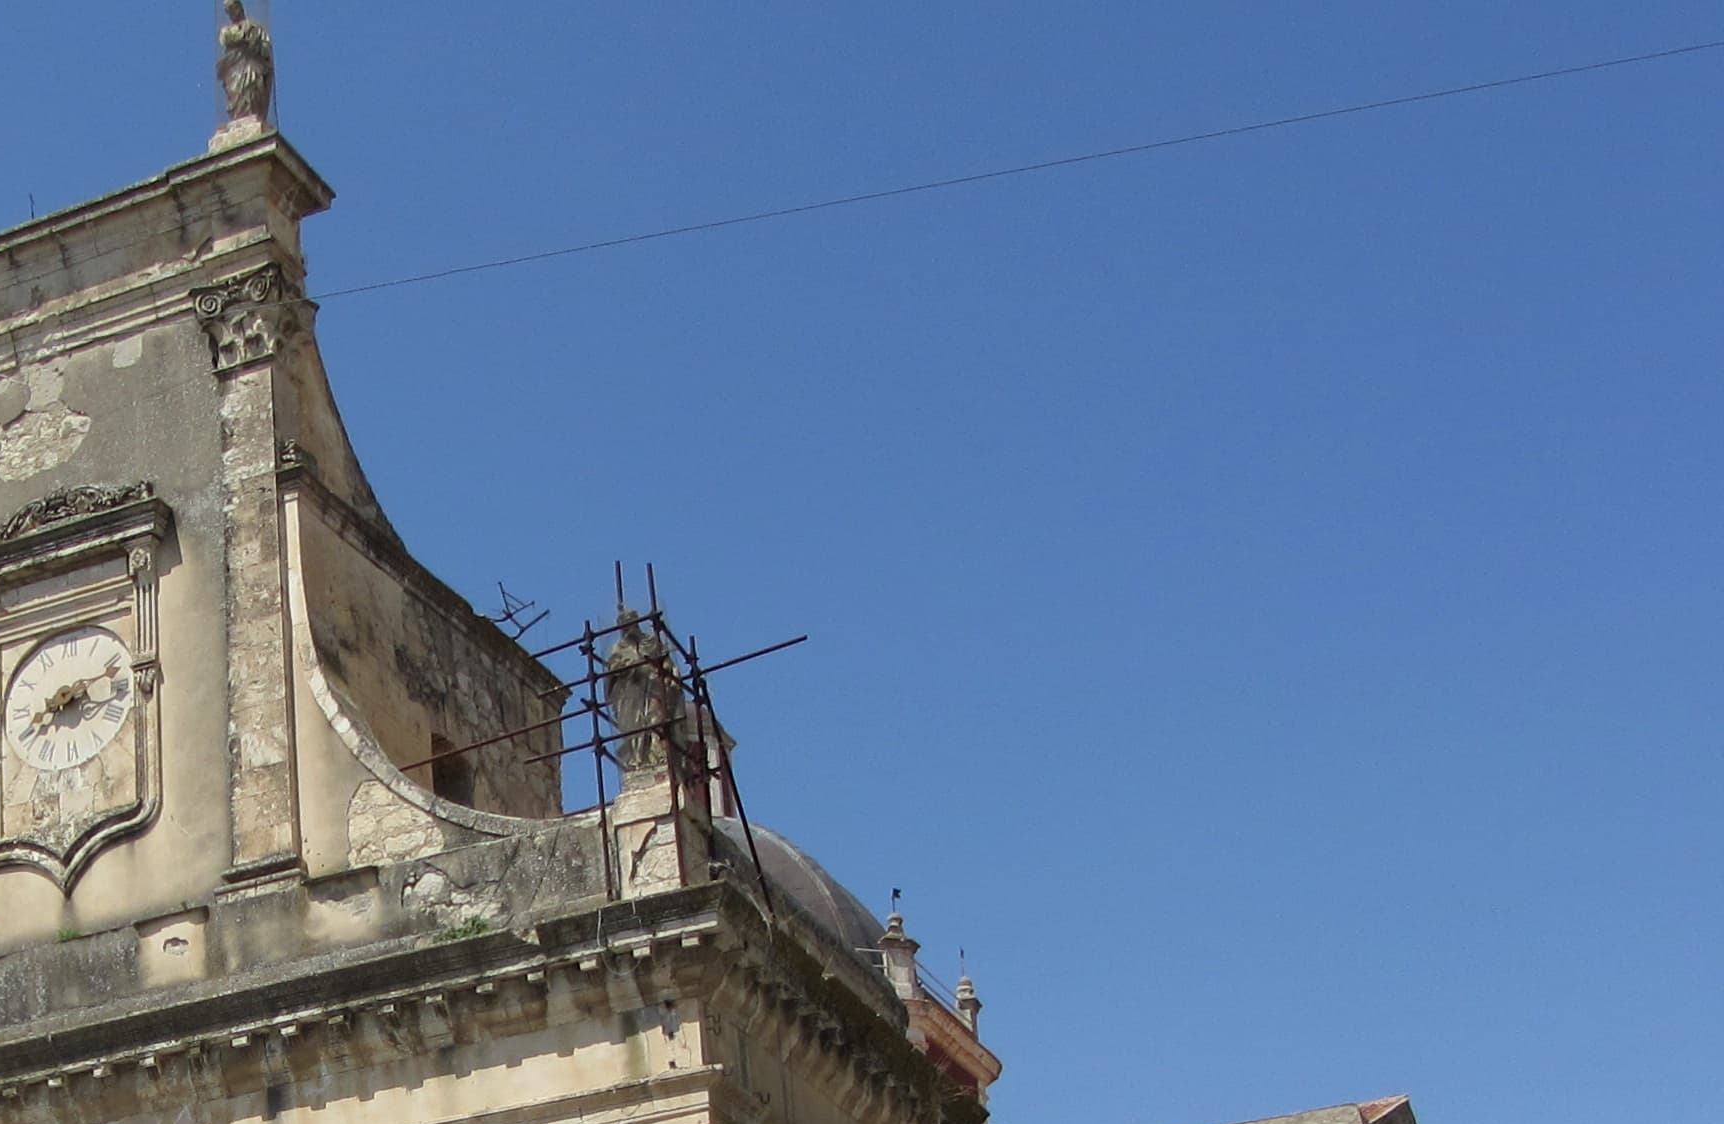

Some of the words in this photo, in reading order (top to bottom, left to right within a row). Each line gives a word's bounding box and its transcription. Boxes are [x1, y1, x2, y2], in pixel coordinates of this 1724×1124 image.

[89, 639, 99, 657] I
[37, 650, 54, 672] XI
[18, 679, 36, 692] X
